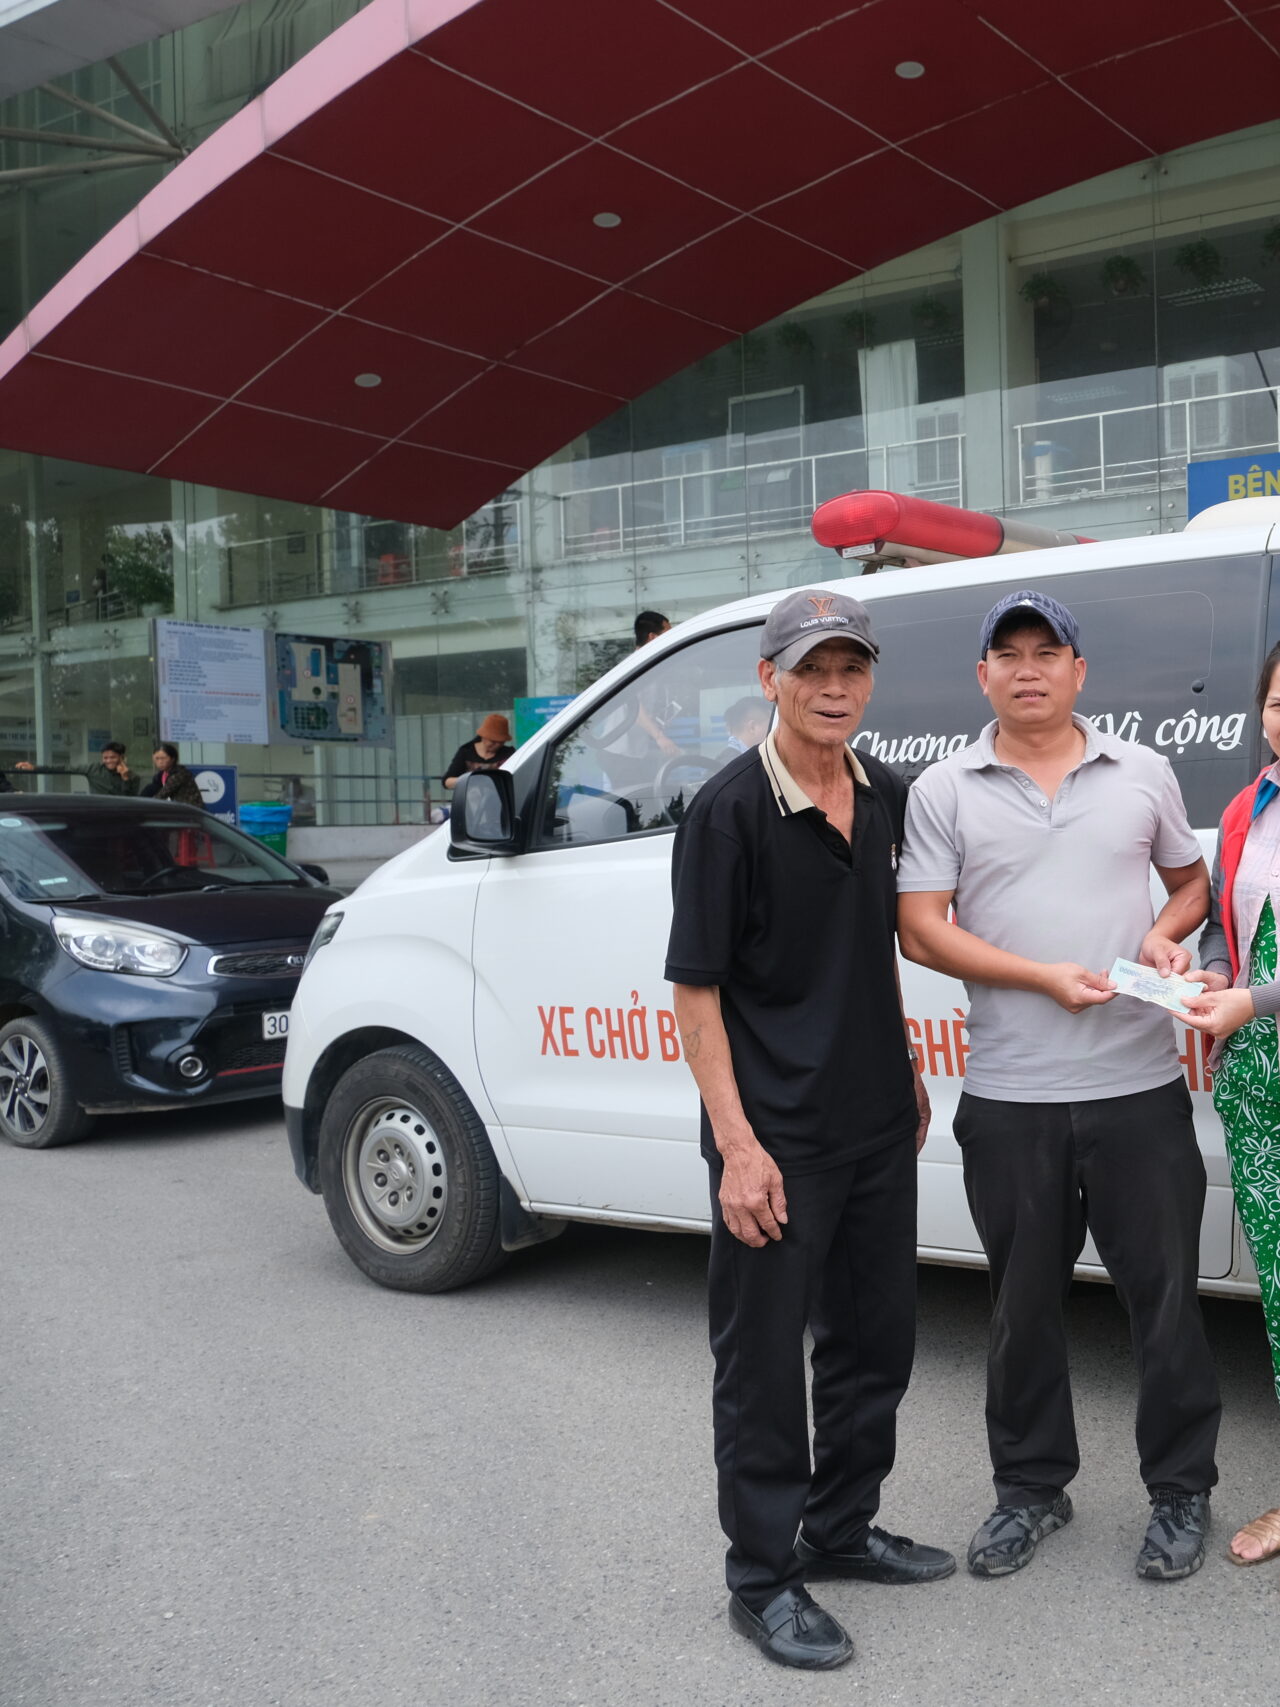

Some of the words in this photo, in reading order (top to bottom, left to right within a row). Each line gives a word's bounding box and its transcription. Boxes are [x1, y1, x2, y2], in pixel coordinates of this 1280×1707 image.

[800, 618, 819, 628] LOUIS
[1155, 708, 1247, 754] cộng
[537, 1005, 580, 1057] XE
[585, 989, 650, 1061] CHỞ
[905, 1008, 970, 1077] GHÈ
